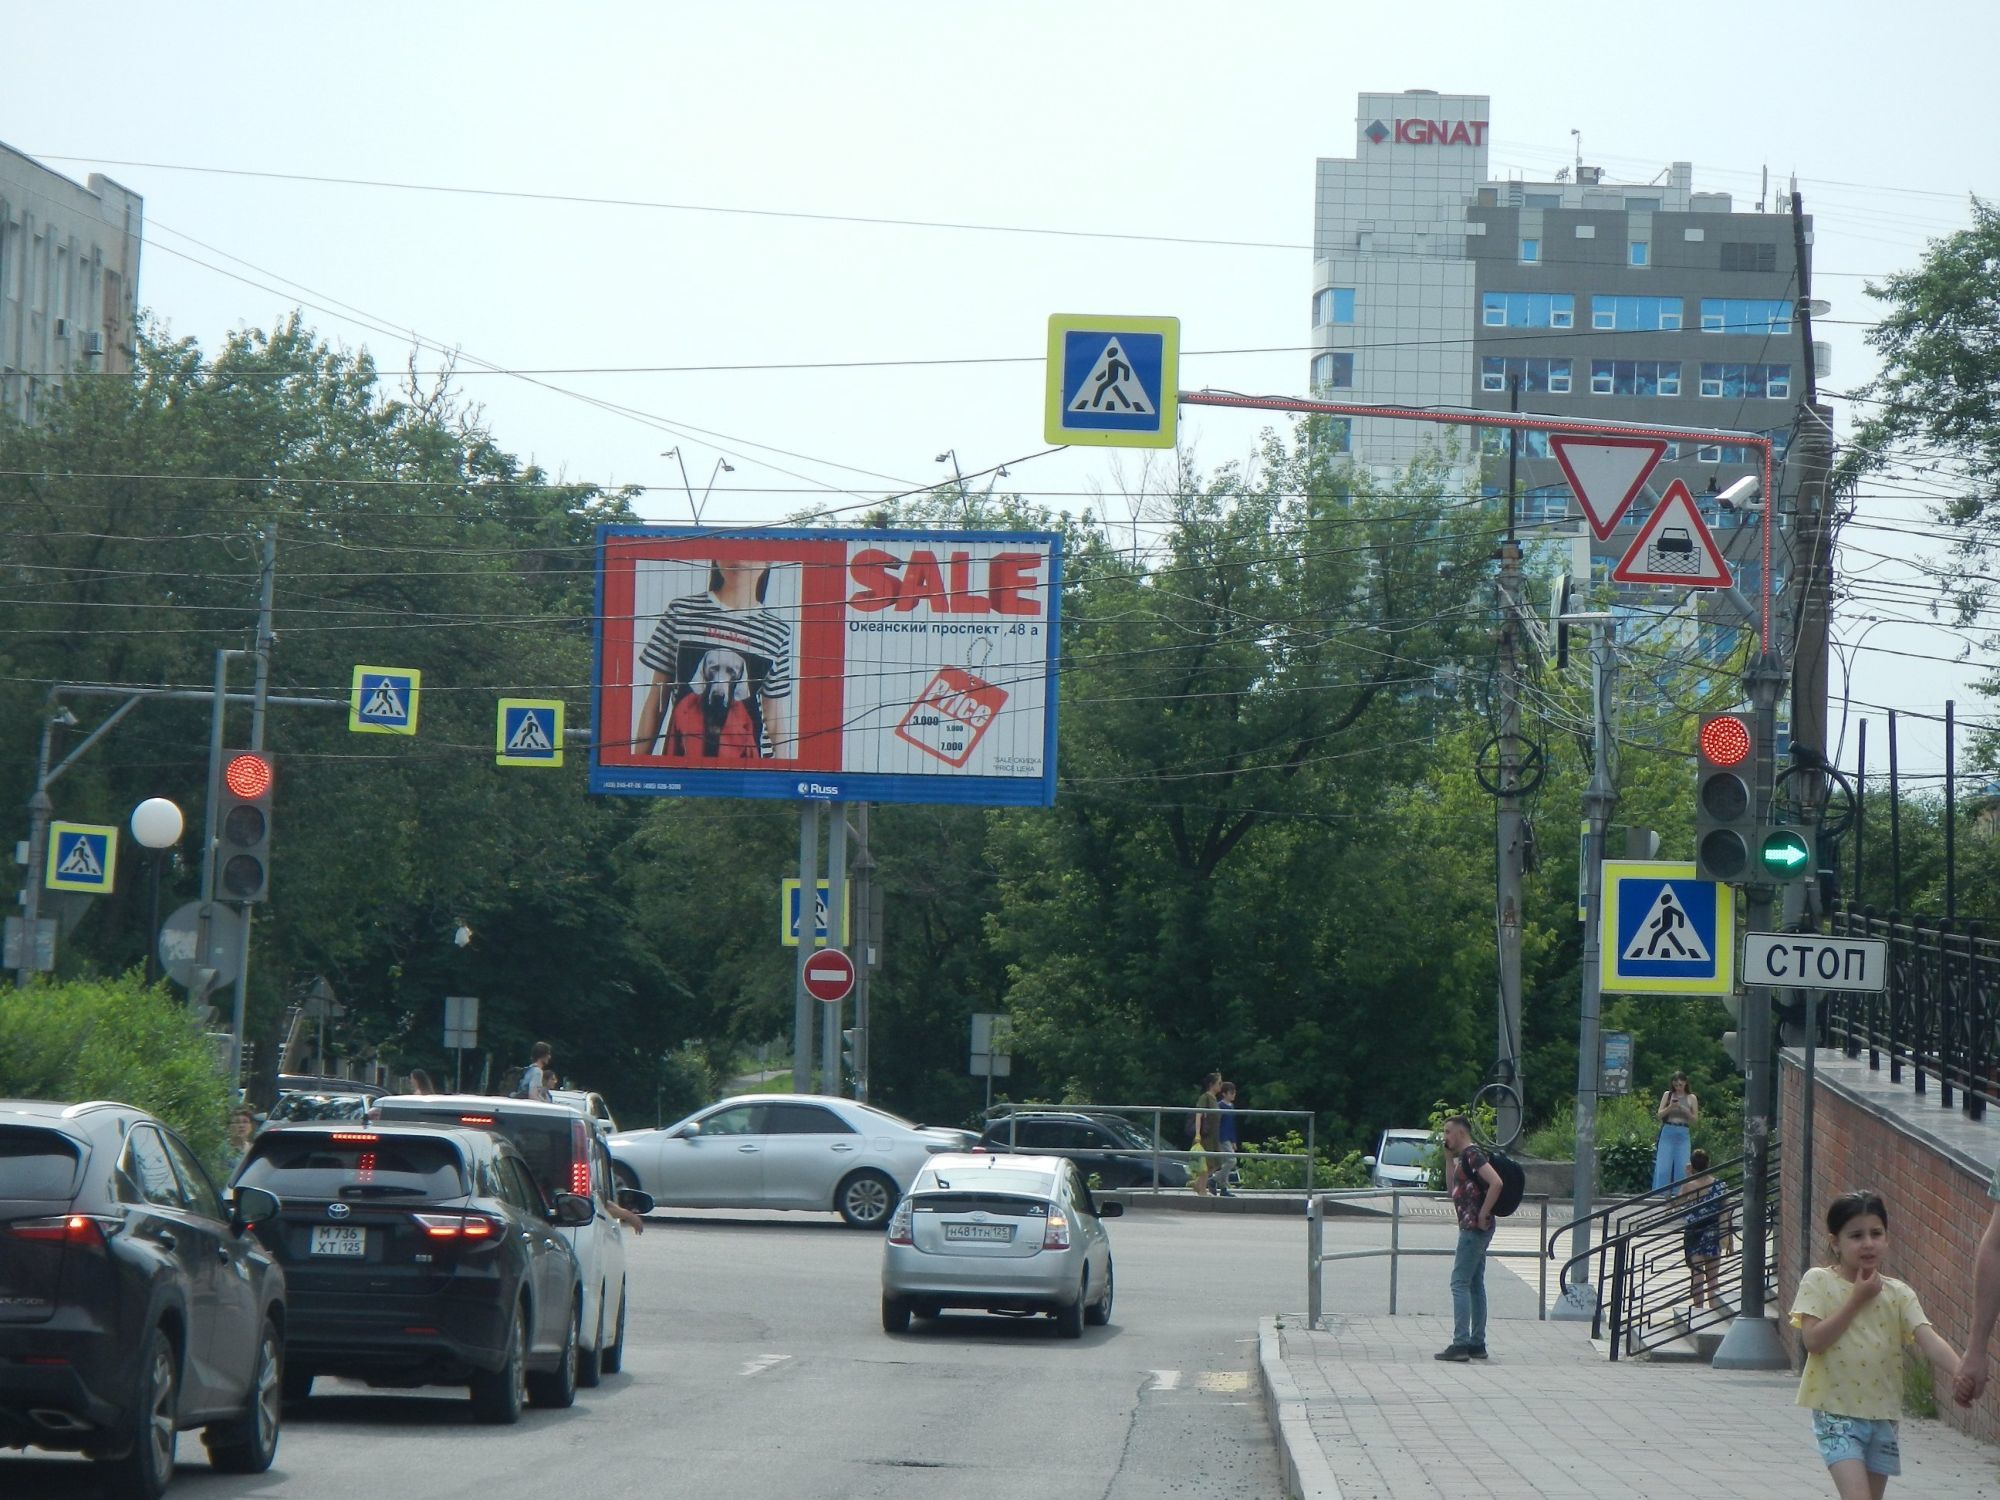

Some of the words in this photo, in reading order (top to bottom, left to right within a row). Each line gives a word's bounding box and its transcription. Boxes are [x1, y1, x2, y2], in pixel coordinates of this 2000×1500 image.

[1395, 118, 1489, 146] IGNAT
[849, 548, 1042, 615] SALE
[849, 620, 927, 633] Океанский
[932, 623, 999, 635] проспект
[913, 715, 939, 726] 3.000
[941, 742, 963, 751] 7.000
[810, 783, 839, 795] Russ
[1766, 944, 1866, 981] СТОП
[335, 1228, 358, 1240] 736
[342, 1242, 360, 1252] 125
